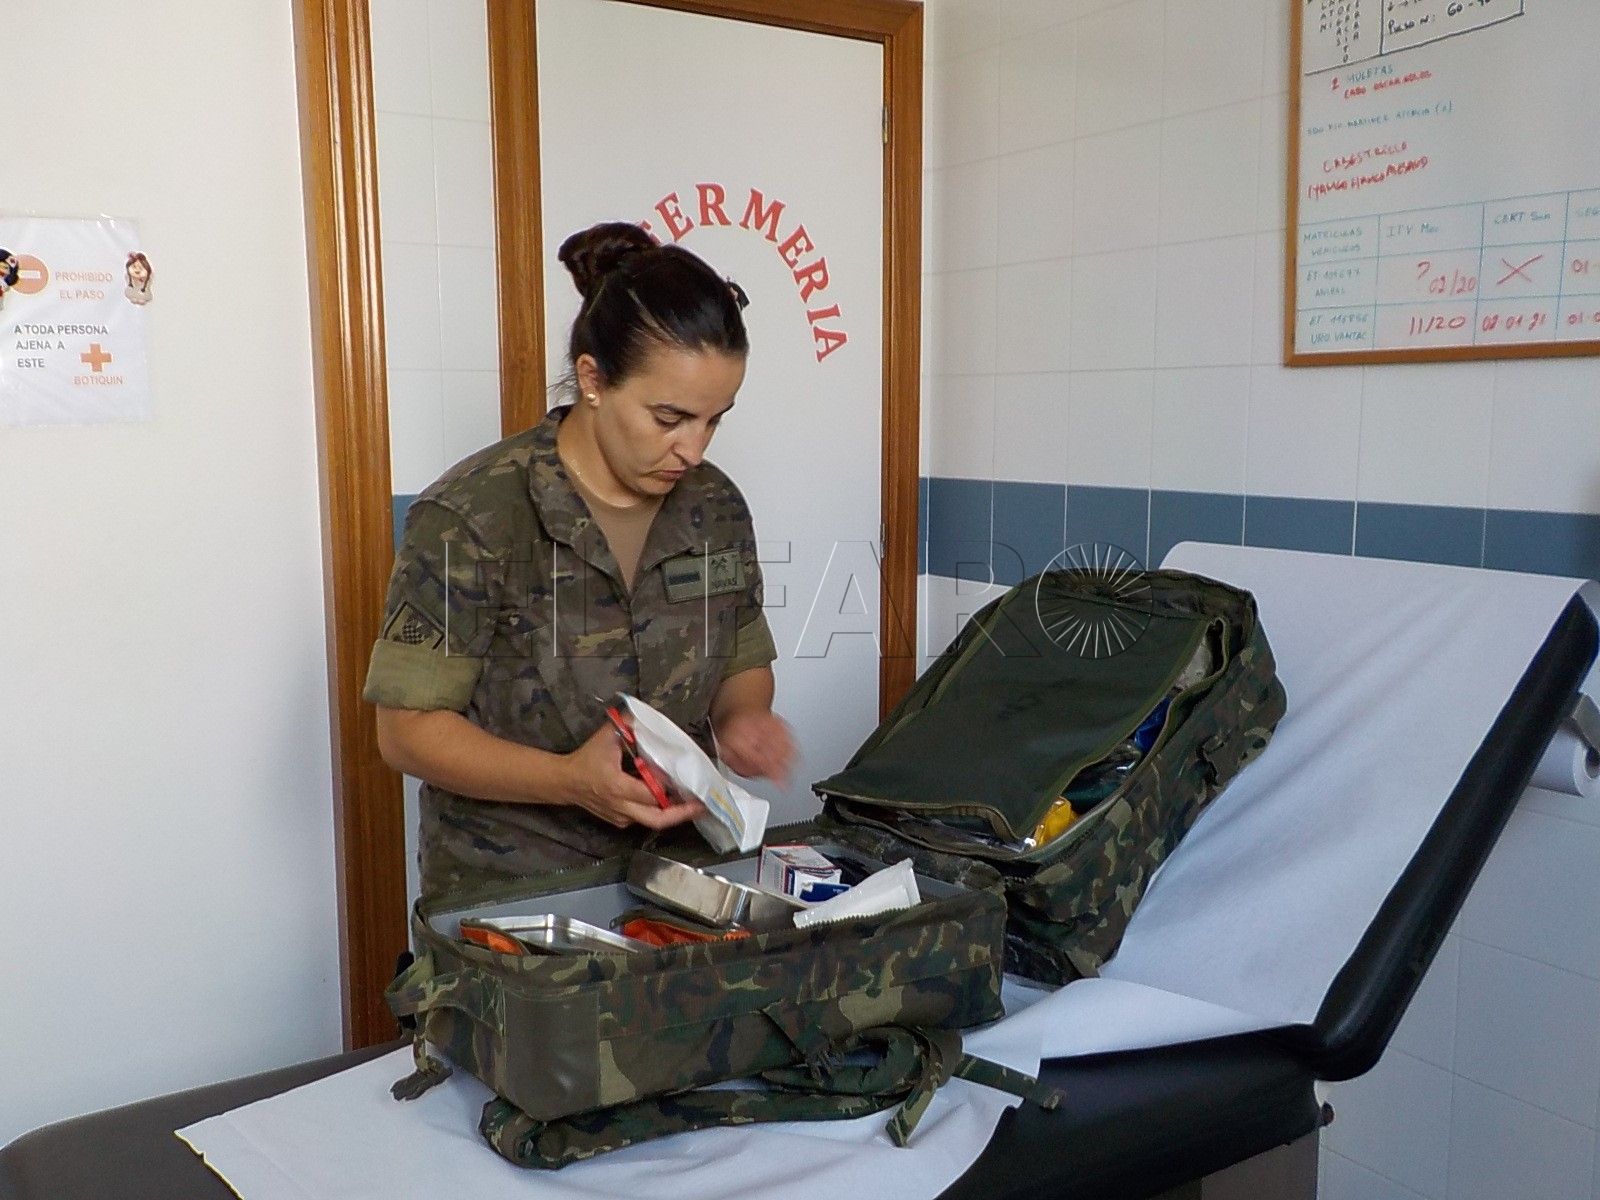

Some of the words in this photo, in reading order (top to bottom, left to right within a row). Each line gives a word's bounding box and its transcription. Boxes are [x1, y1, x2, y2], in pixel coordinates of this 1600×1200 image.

[55, 271, 113, 283] PROHIBIDO
[59, 289, 73, 300] EL
[75, 289, 104, 300] PASO
[14, 325, 22, 335] A
[24, 325, 54, 335] TODA
[57, 325, 108, 335] PERSONA
[1409, 315, 1466, 336] 11/20
[16, 341, 51, 350] AJENA
[57, 341, 65, 350] A
[17, 358, 45, 368] ESTE
[74, 376, 123, 385] BOTIQUIN
